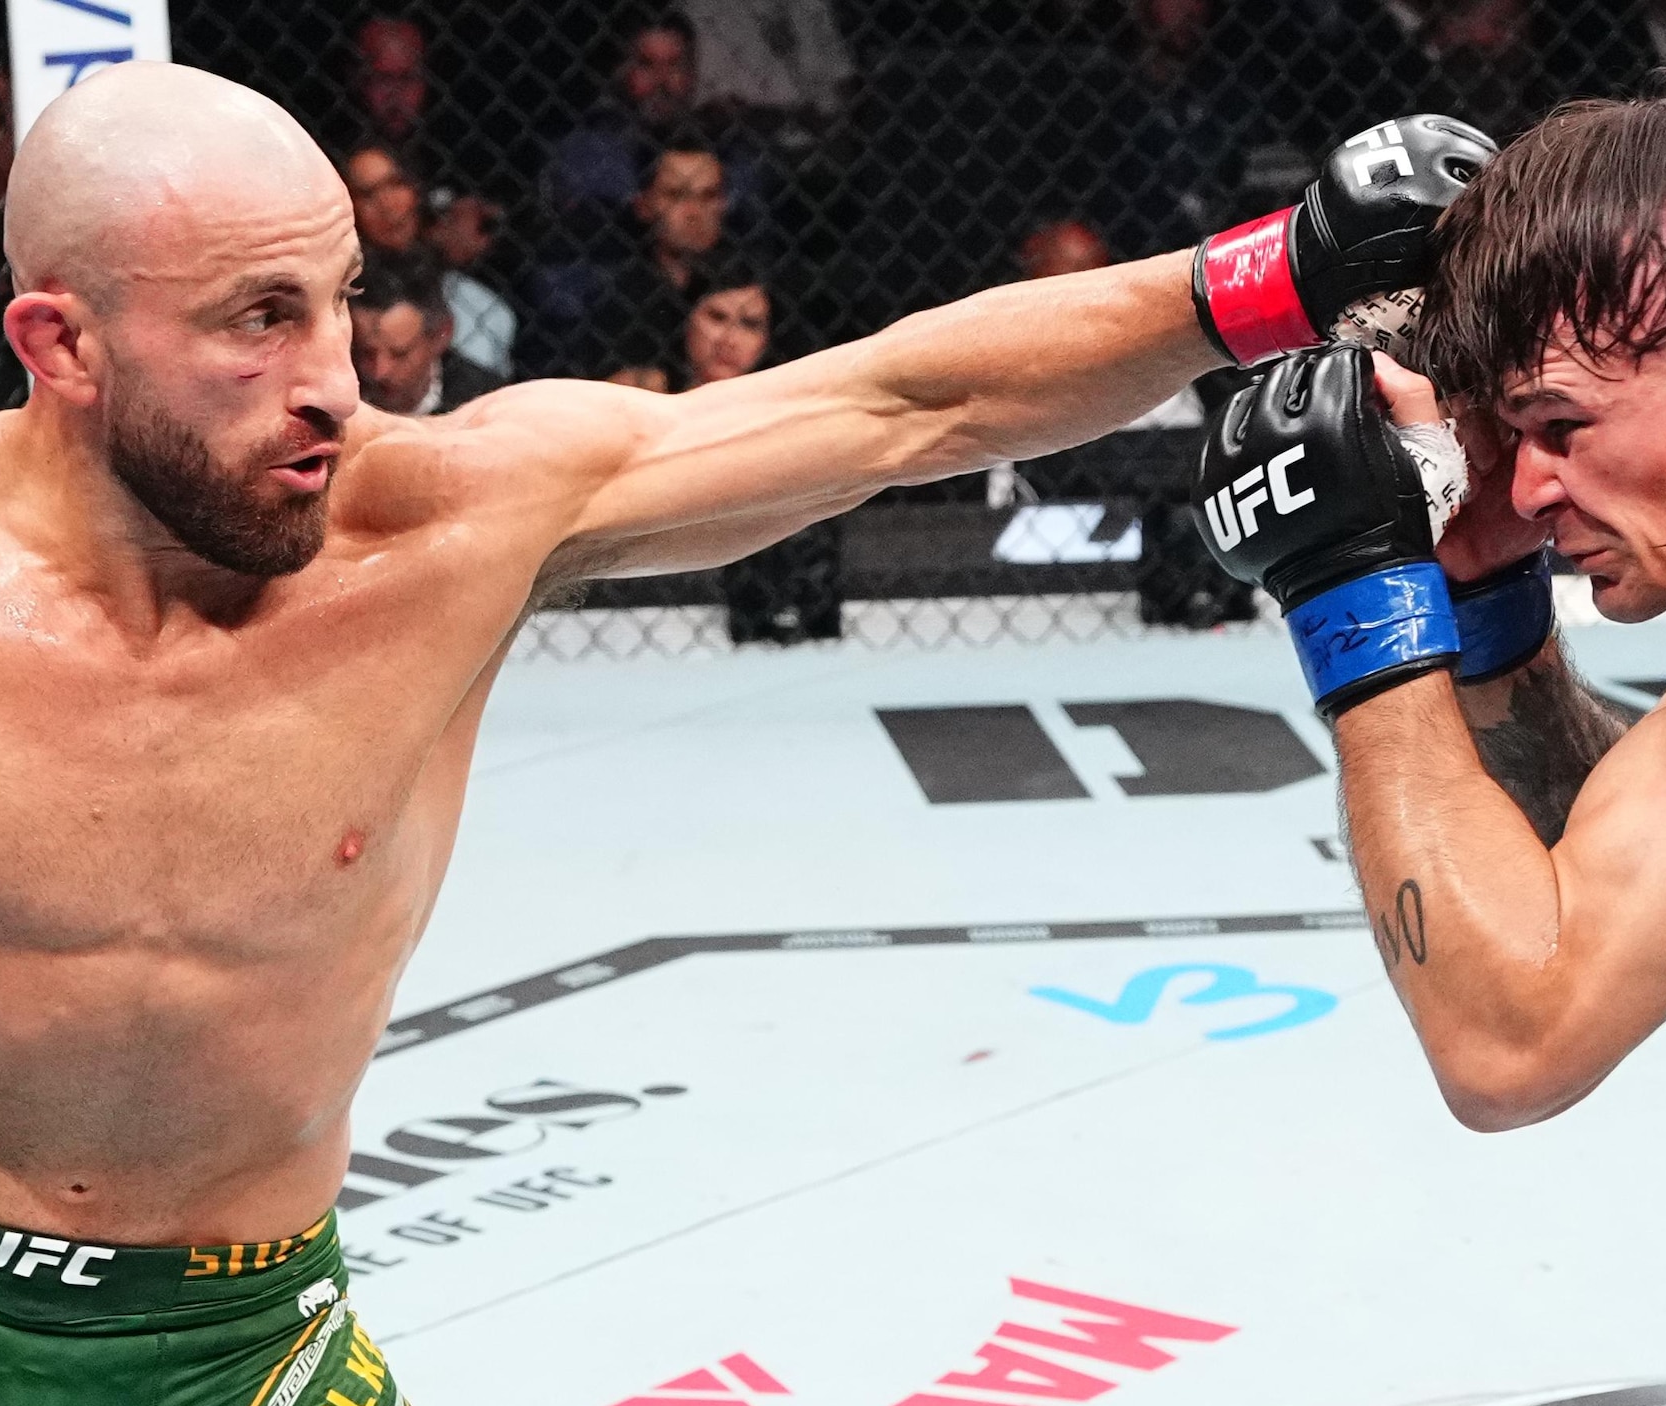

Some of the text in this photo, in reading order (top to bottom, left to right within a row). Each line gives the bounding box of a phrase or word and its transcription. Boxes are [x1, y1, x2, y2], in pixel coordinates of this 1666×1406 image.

[1345, 120, 1414, 187] FC
[1203, 443, 1317, 552] UFC
[387, 1210, 483, 1246] OF
[473, 1166, 614, 1212] UFC
